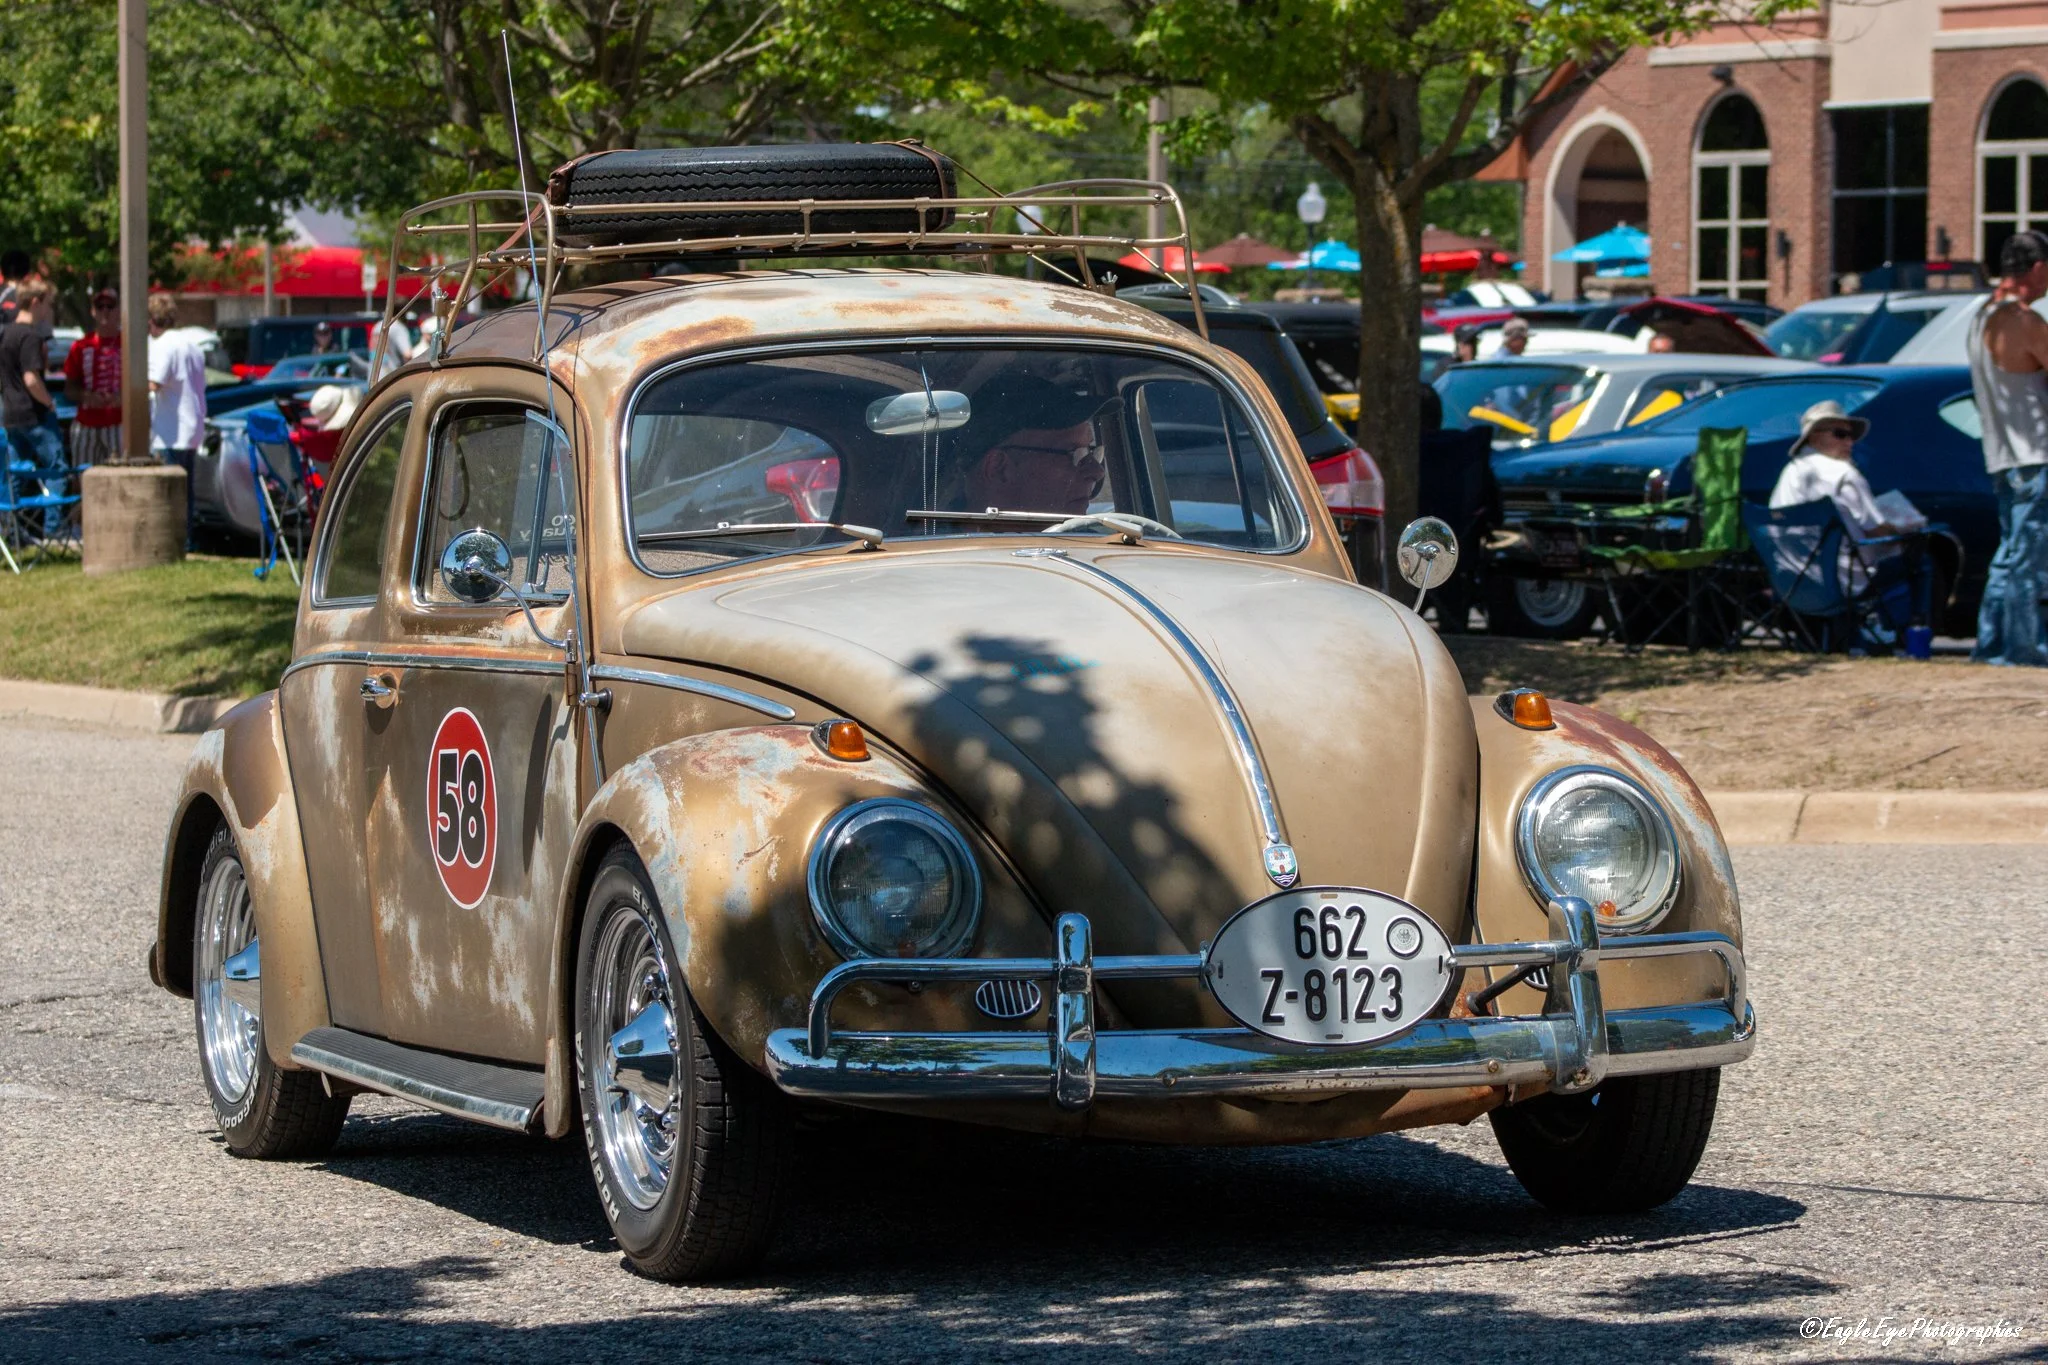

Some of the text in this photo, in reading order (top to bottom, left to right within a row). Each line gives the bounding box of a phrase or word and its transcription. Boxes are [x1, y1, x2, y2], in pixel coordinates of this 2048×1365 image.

[437, 748, 487, 869] 58
[1294, 905, 1368, 960] 662
[1260, 967, 1403, 1024] Z-8123
